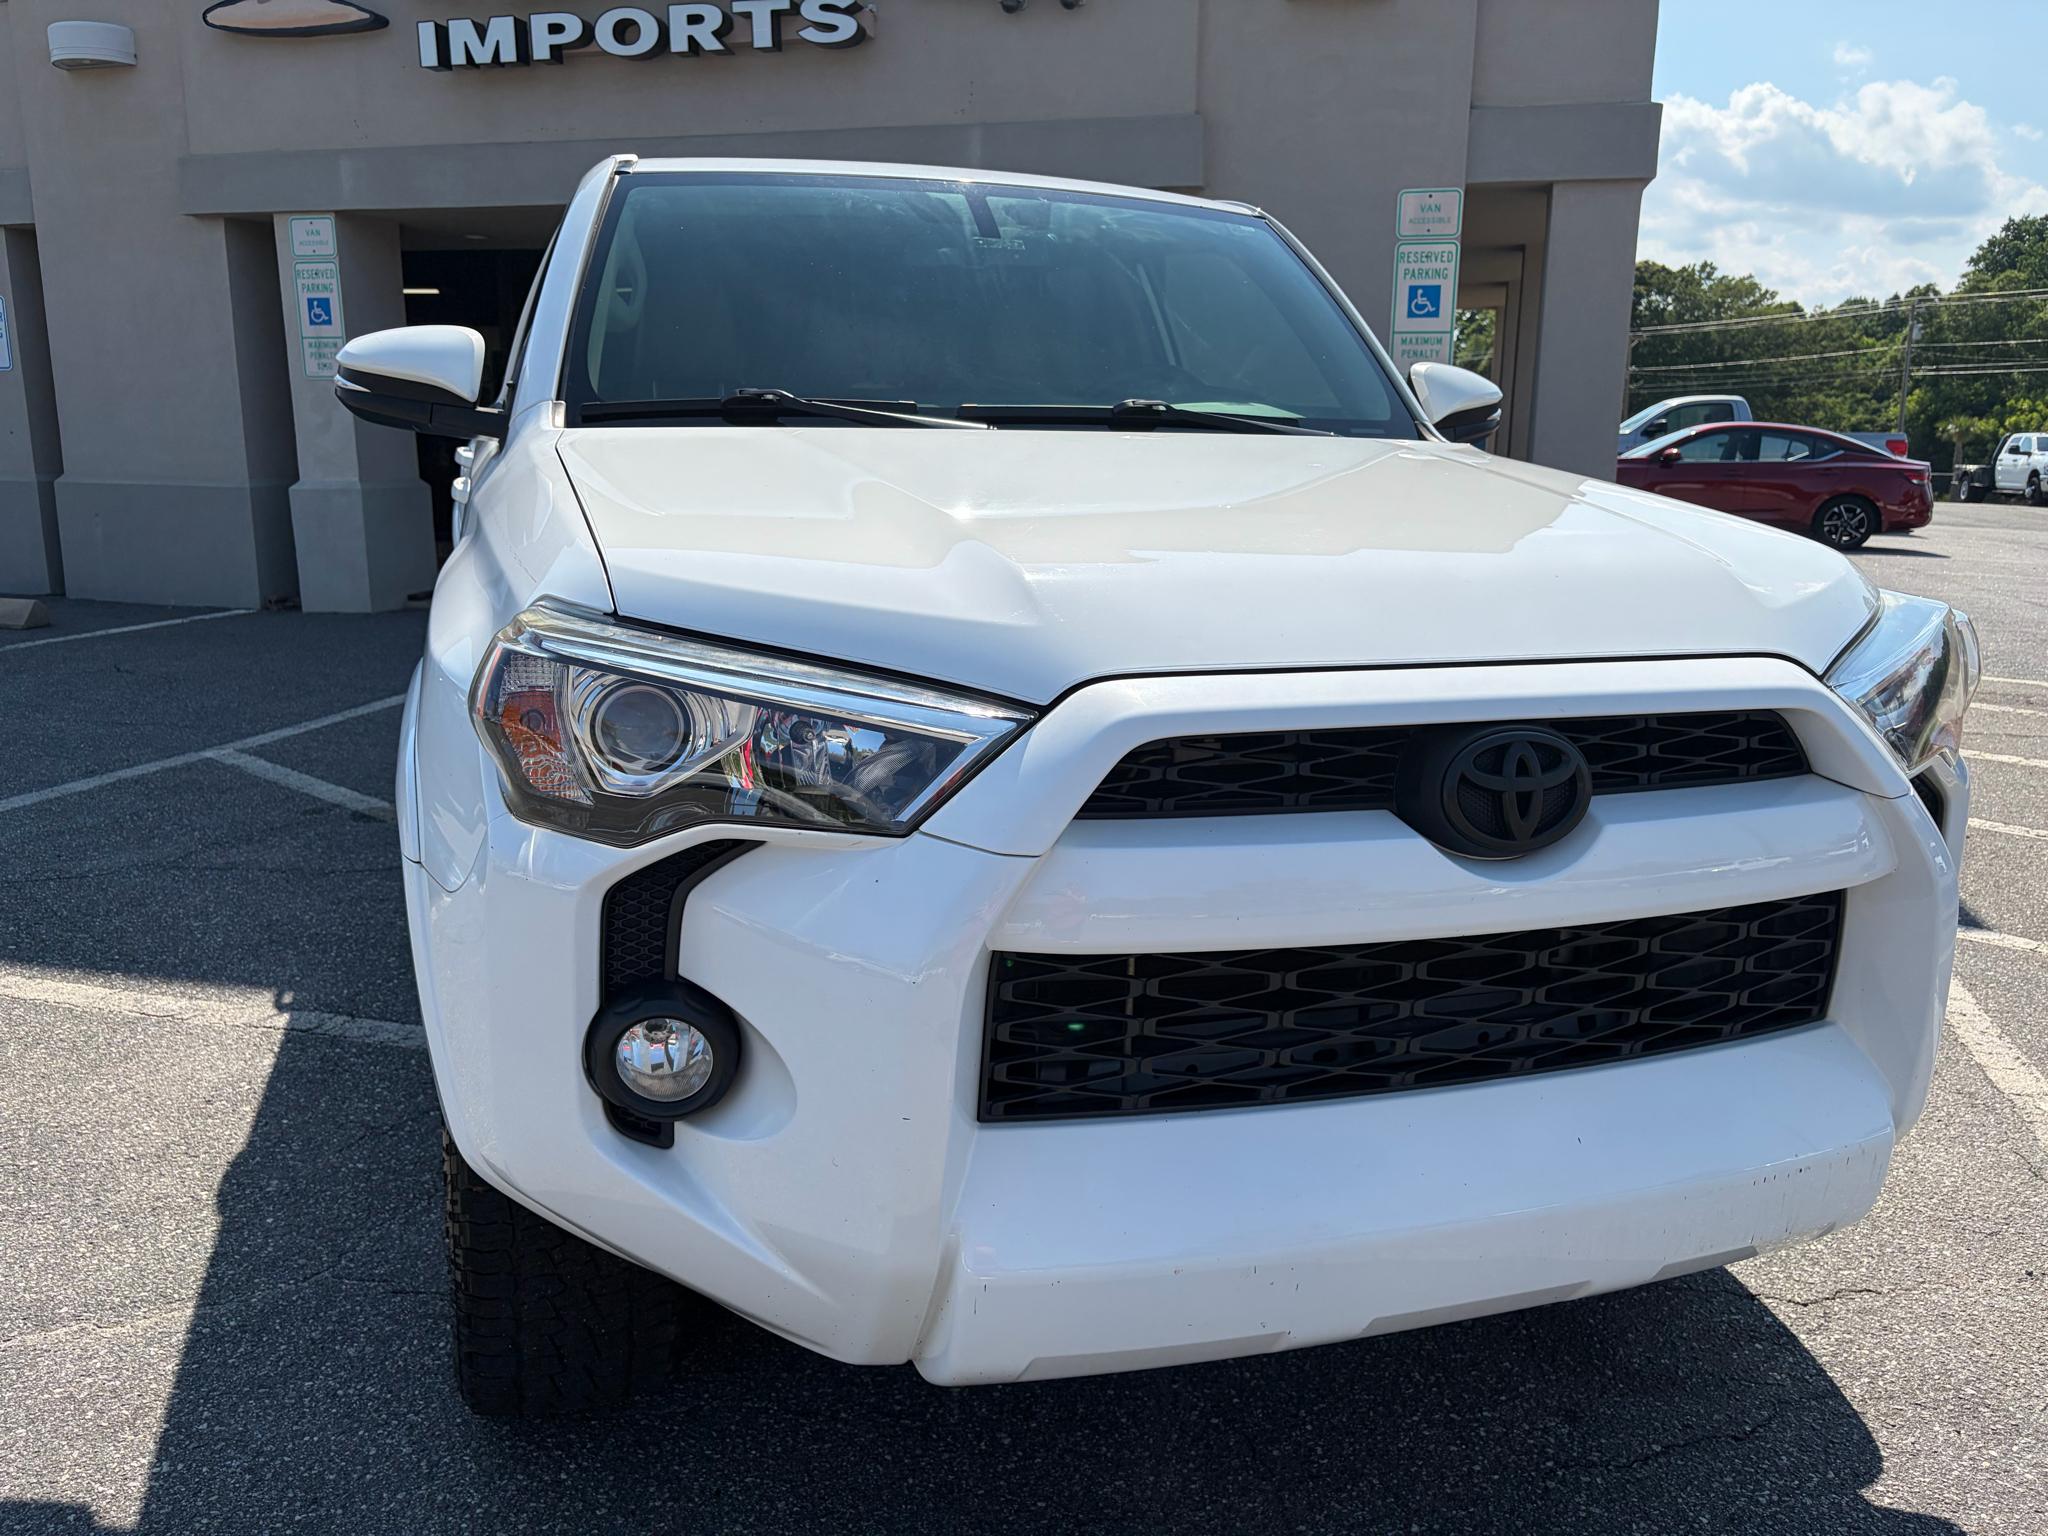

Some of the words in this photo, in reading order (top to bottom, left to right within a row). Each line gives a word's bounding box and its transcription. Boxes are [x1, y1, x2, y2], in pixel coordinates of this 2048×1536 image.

[417, 0, 860, 70] IMPORTS
[1420, 203, 1442, 213] VAN
[304, 228, 321, 237] VAN
[1399, 250, 1454, 264] RESERVED
[296, 268, 336, 280] RESERVED
[1403, 267, 1449, 280] PARKING
[301, 282, 334, 294] PARKING
[1401, 335, 1443, 346] MAXIMUM
[1401, 348, 1441, 359] PENALTY
